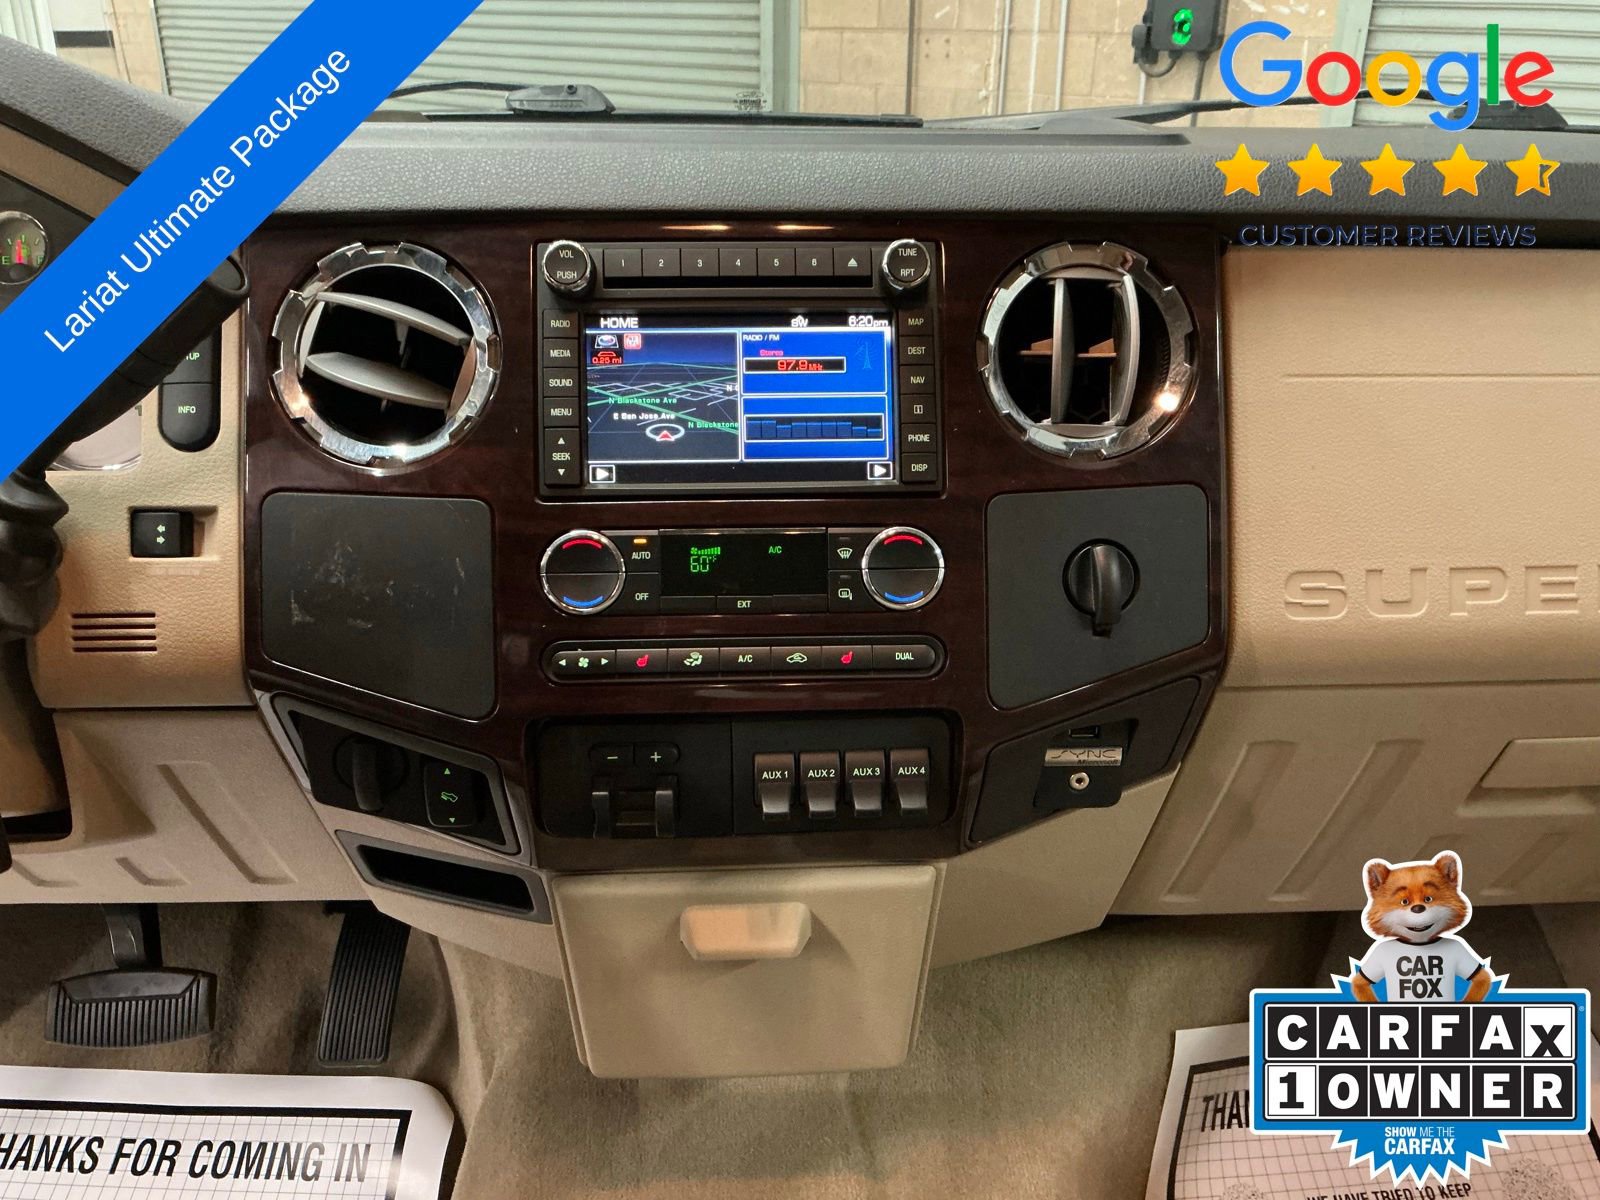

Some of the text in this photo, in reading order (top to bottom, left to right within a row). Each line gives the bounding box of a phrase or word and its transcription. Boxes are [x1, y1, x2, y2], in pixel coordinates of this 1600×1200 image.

[559, 249, 574, 259] VOL
[898, 248, 918, 257] TUNE
[2, 255, 11, 265] E
[658, 259, 664, 268] 2
[697, 259, 703, 268] 3
[735, 258, 742, 267] 4
[773, 258, 780, 267] 5
[556, 271, 577, 279] PUSH
[900, 268, 916, 277] RPT
[550, 319, 571, 328] RADIO
[600, 317, 639, 329] HOME
[907, 318, 925, 326] MAP
[549, 349, 571, 358] MEDIA
[907, 346, 926, 355] DEST
[549, 378, 573, 387] SOUND
[910, 376, 925, 384] NAV
[177, 405, 196, 414] INFO
[550, 408, 572, 416] MENU
[907, 434, 930, 442] PHONE
[552, 452, 571, 461] SEEK
[911, 463, 928, 472] DISP
[768, 545, 783, 554] A/C
[631, 551, 651, 560] AUTO
[635, 592, 649, 601] OFF
[1283, 564, 1600, 620] SUPE
[737, 600, 752, 608] EXT
[737, 654, 753, 662] A/C
[895, 652, 914, 660] DUAL
[1051, 749, 1117, 759] SYNC
[761, 771, 782, 779] AUX
[807, 769, 836, 778] AUX 2
[852, 767, 881, 776] AUX 3
[897, 766, 926, 775] AUX 4
[108, 1138, 182, 1177] FOR
[188, 1139, 325, 1182] COMING
[333, 1142, 372, 1182] IN
[1438, 1182, 1472, 1199] KEEP
